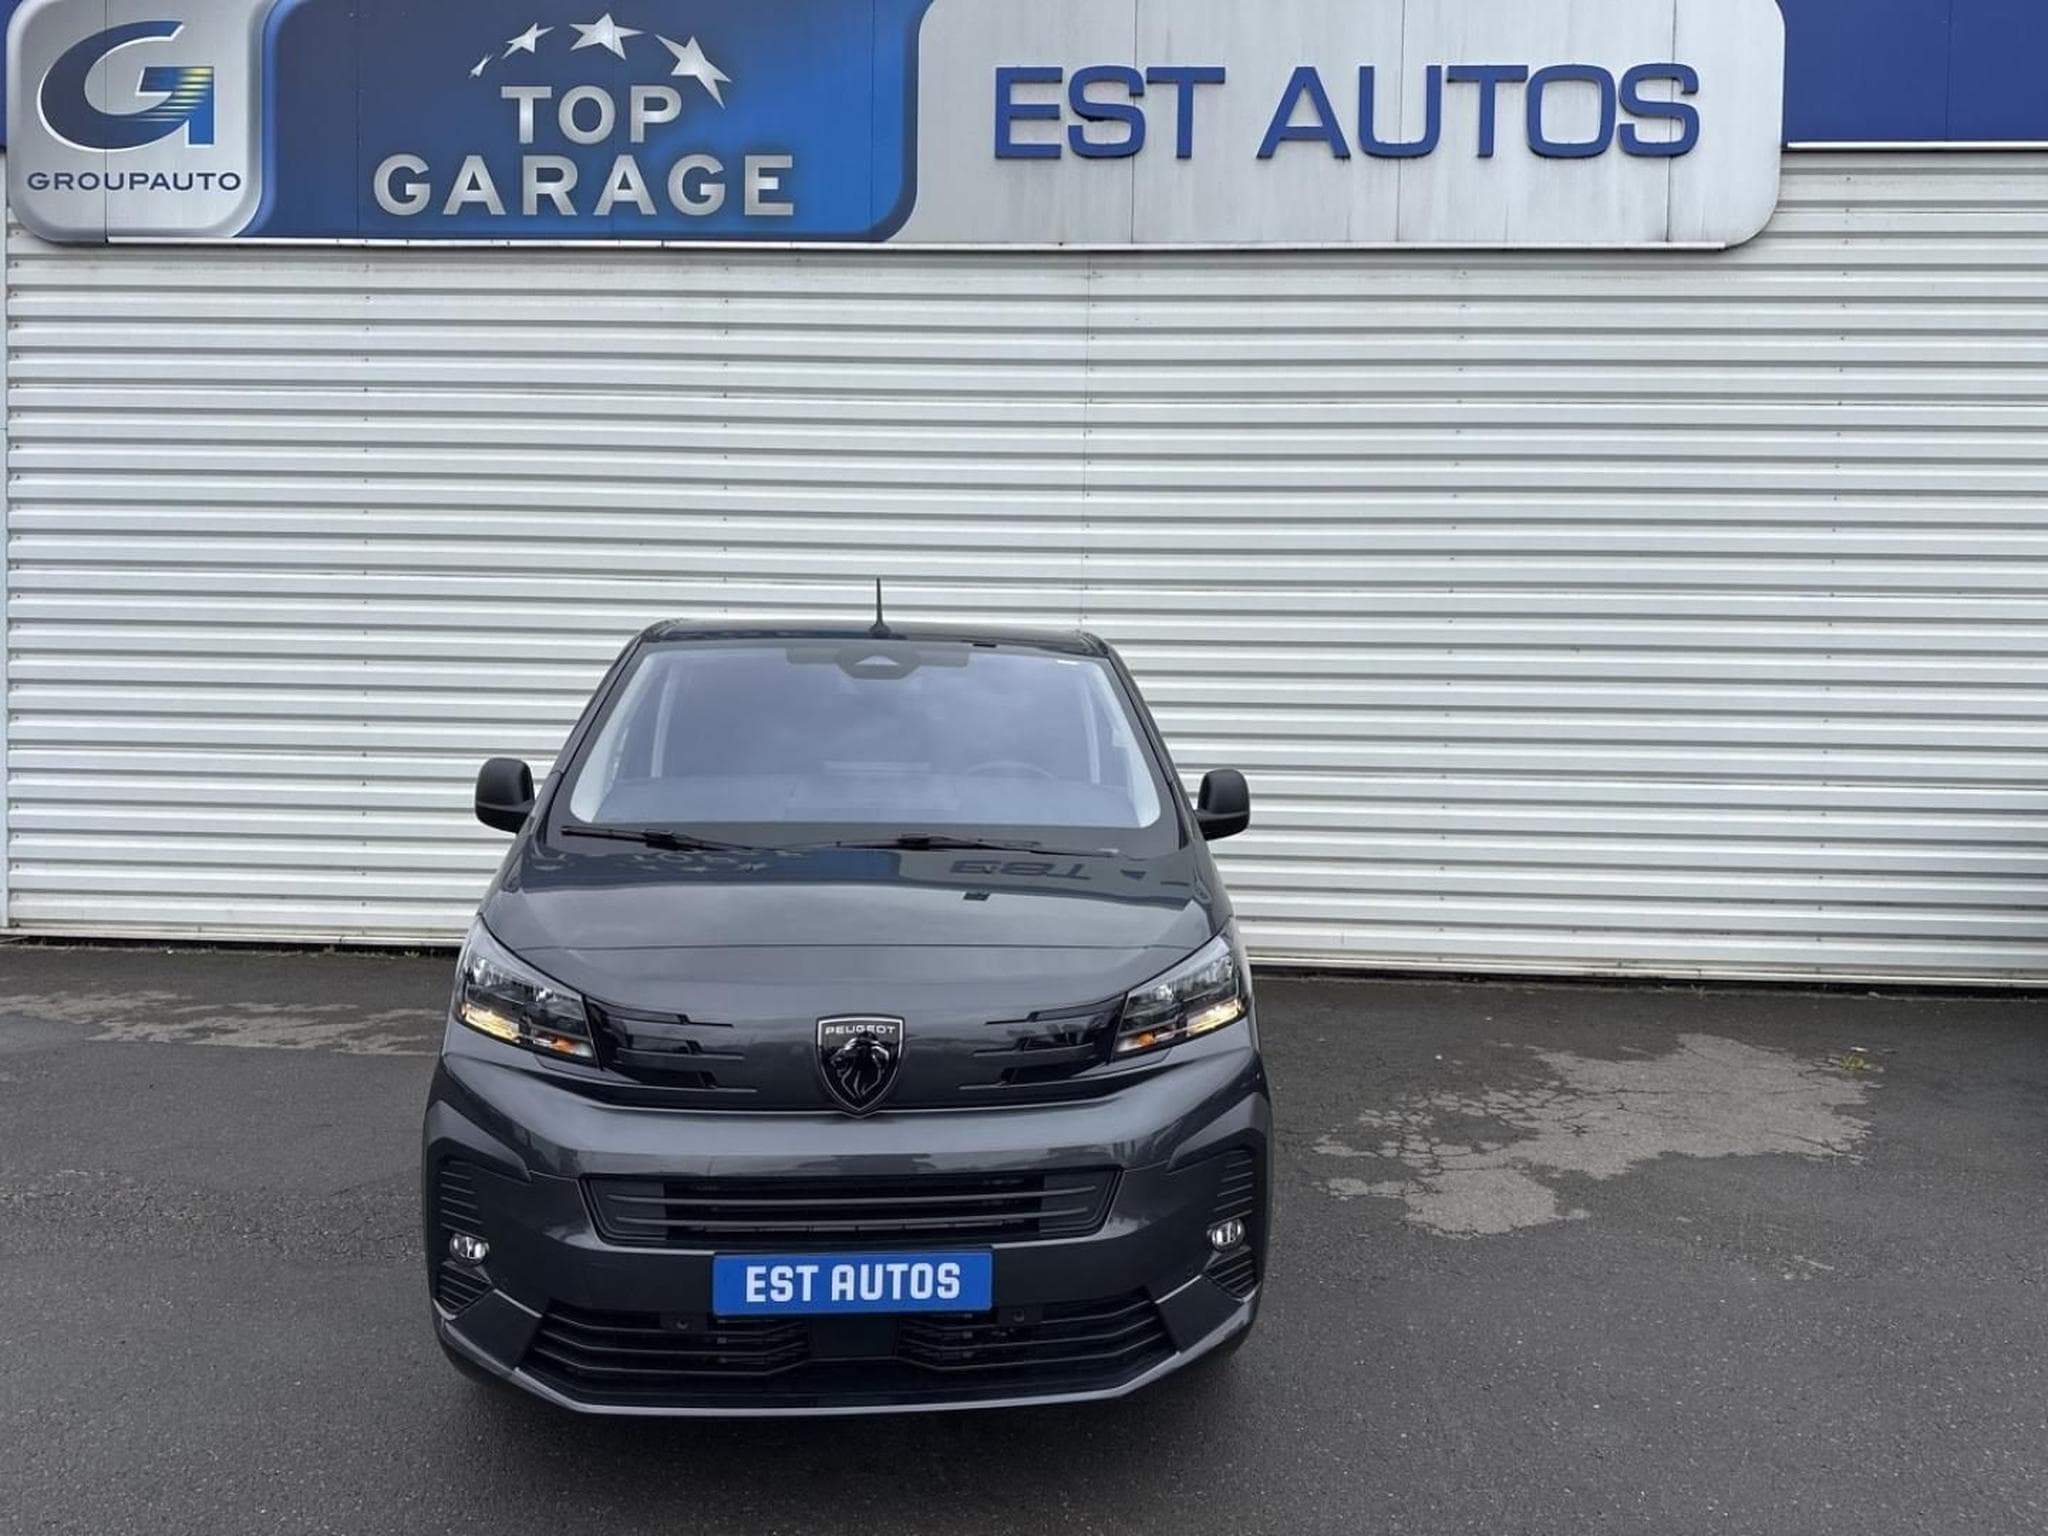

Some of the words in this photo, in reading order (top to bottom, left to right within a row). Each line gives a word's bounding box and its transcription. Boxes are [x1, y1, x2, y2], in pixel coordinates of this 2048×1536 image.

[501, 85, 683, 145] TOP
[995, 65, 1225, 159] EST
[1256, 63, 1701, 159] AUTOS
[27, 171, 242, 191] GROUPAUTO
[374, 154, 794, 217] GARAGE
[825, 1024, 896, 1034] PEUGEOT
[746, 1265, 819, 1303] EST
[831, 1262, 961, 1302] AUTOS
